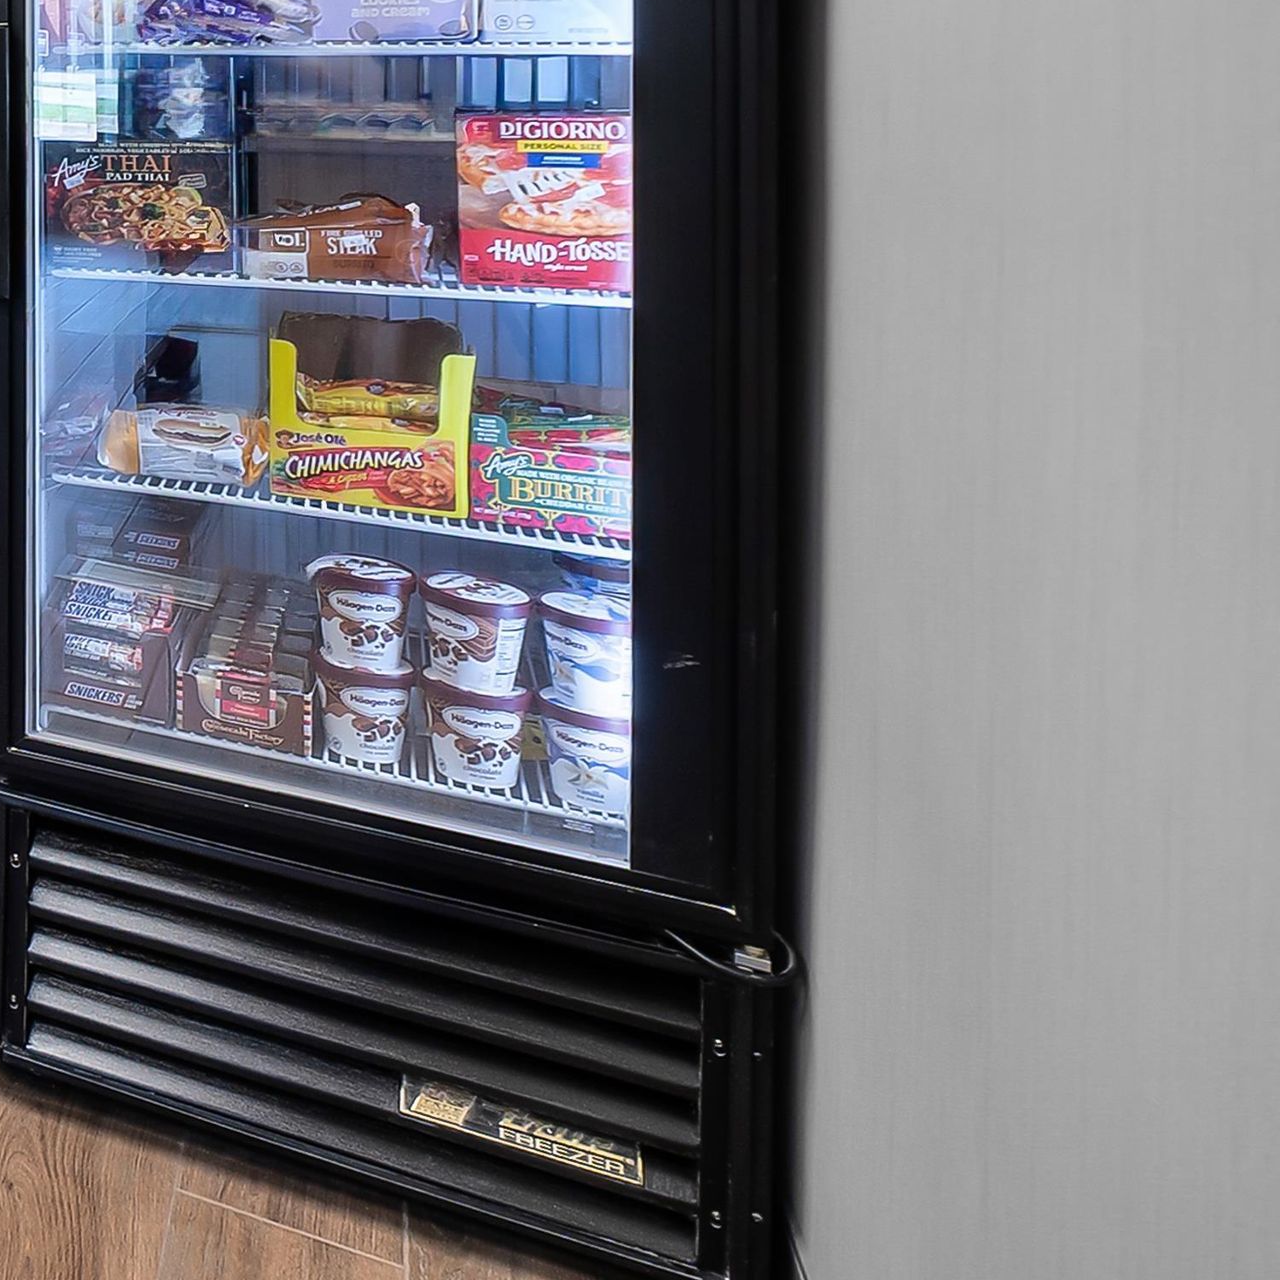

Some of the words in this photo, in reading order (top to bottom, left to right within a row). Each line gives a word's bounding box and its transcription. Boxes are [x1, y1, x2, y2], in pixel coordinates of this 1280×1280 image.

[350, 7, 379, 18] AND
[381, 7, 430, 18] CREAM
[52, 155, 101, 186] Amy's
[101, 154, 172, 172] THAI
[106, 172, 133, 182] PAD
[136, 172, 170, 182] THAI
[486, 237, 631, 266] HAND-TOSSE
[285, 450, 424, 479] CHIMICHANGAS
[486, 453, 529, 477] Amy's
[67, 683, 122, 704] SNICKERS
[498, 1127, 625, 1174] FREEZER
